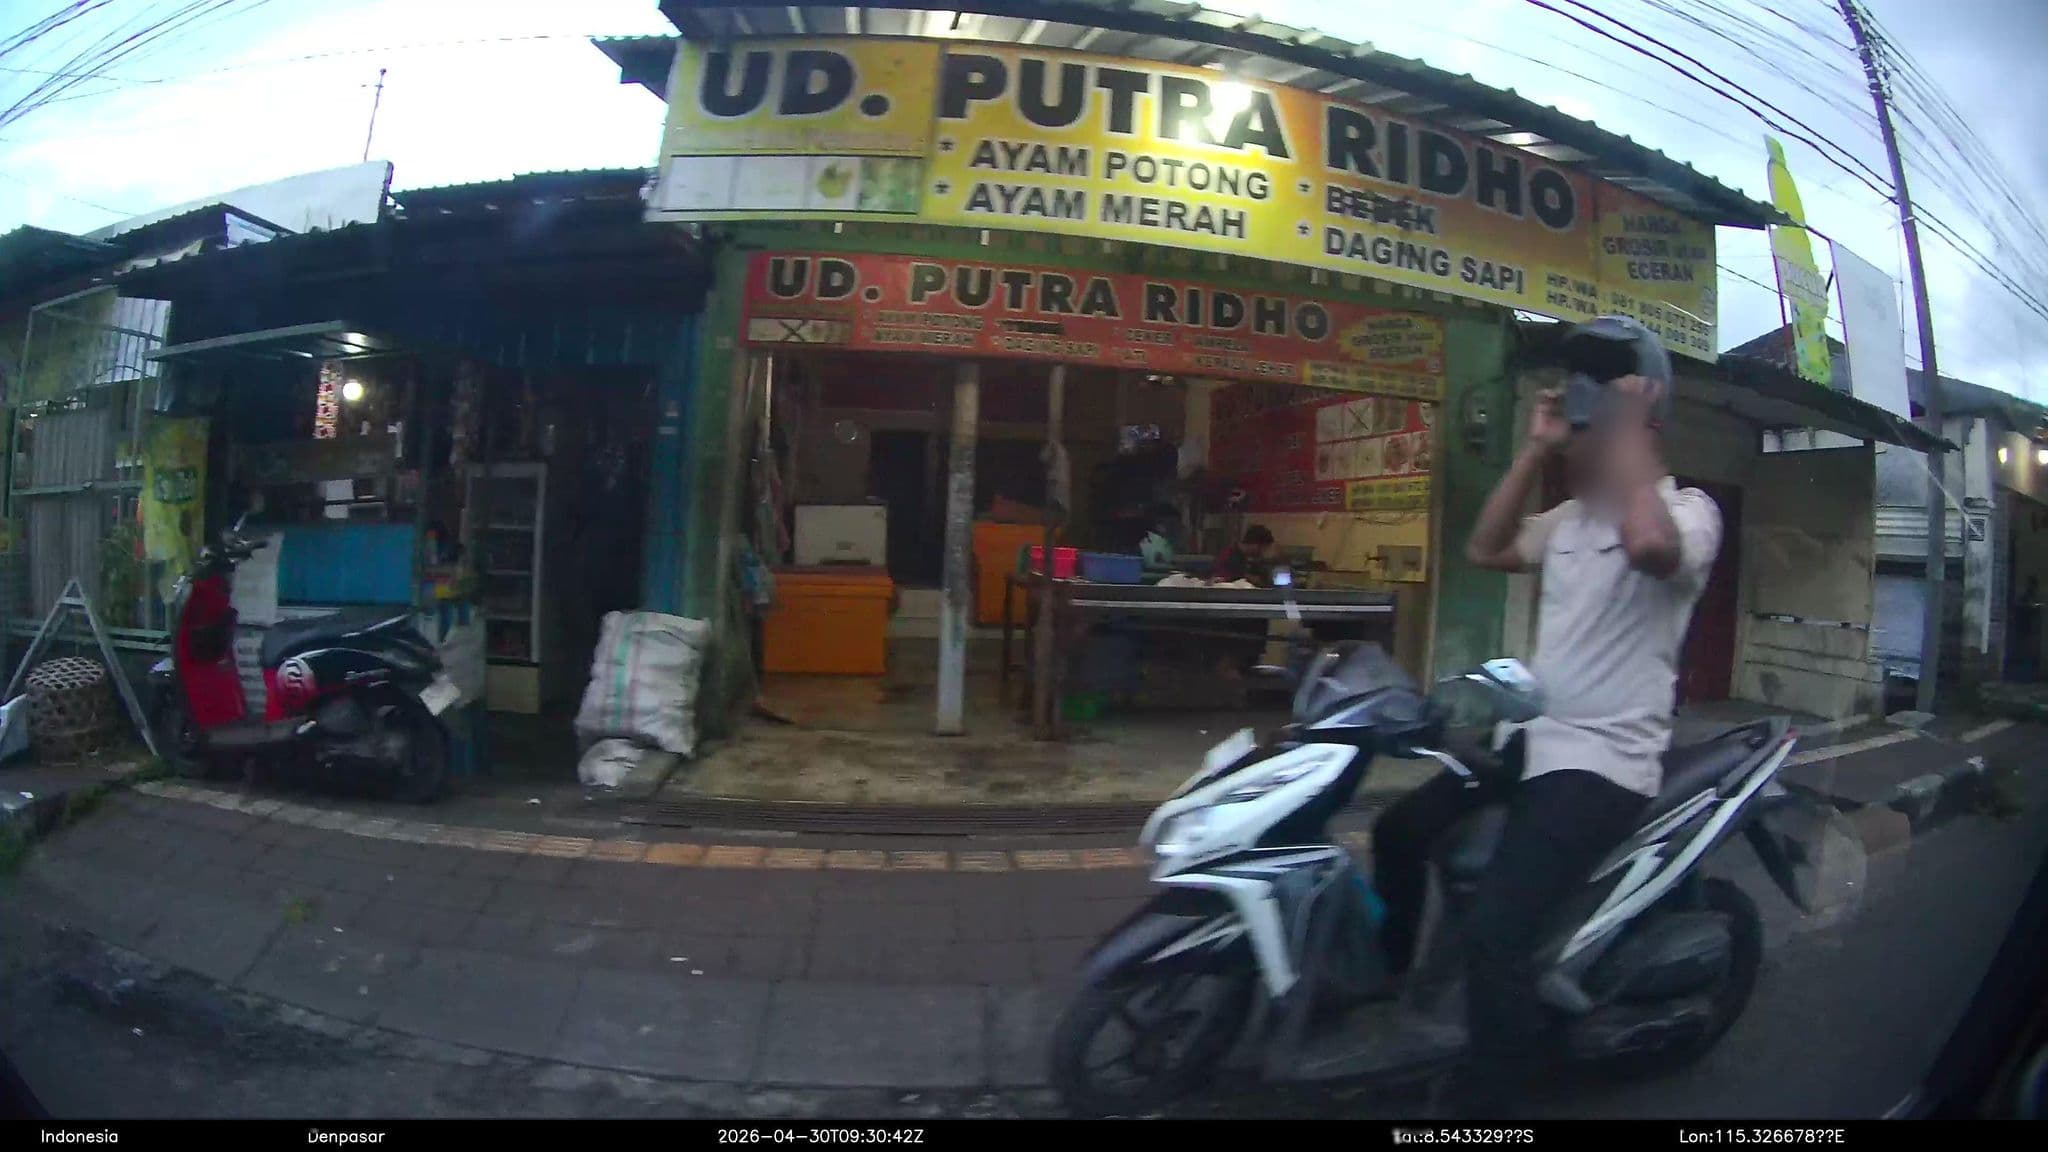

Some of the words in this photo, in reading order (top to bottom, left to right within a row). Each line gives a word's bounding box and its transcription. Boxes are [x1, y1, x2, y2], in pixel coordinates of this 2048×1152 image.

[700, 49, 890, 118] UD.
[939, 54, 1291, 159] PUTRA
[1327, 104, 1577, 230] RIDHO
[971, 140, 1087, 177] AYAM
[1105, 153, 1269, 200] POTONG
[965, 183, 1084, 220] AYAM
[1101, 193, 1246, 239] MERAH
[1326, 227, 1450, 277] DAGING
[1460, 255, 1524, 296] SAPI
[1626, 261, 1694, 282] ECERAN
[769, 257, 880, 301] UD.
[910, 262, 1122, 319] PUTRA
[1144, 281, 1332, 341] RIDHO
